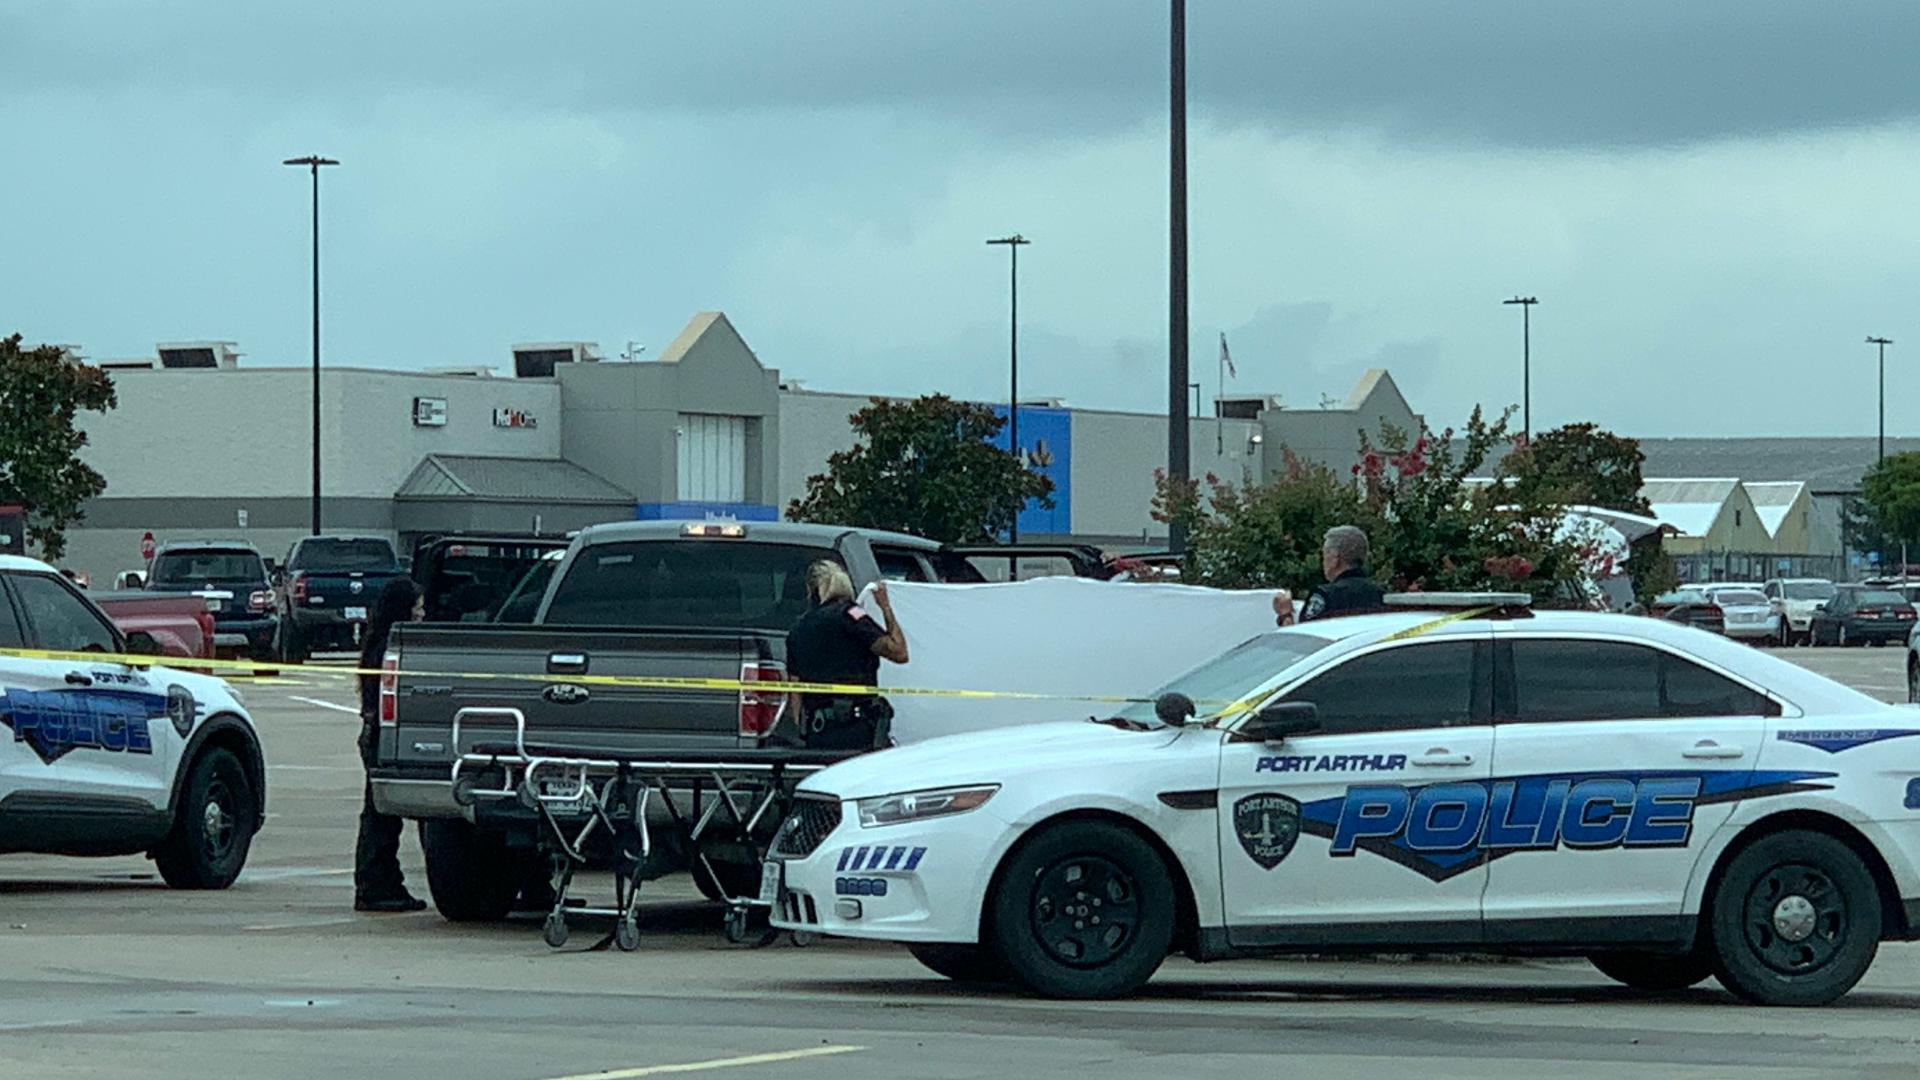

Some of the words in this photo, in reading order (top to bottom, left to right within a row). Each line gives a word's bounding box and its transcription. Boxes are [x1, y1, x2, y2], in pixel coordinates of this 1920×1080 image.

[5, 688, 152, 754] POLICE
[1256, 756, 1316, 772] PORT
[1314, 755, 1407, 772] ARTHUR
[1238, 799, 1262, 815] PORT
[1329, 777, 1701, 858] POLICE
[1254, 846, 1284, 857] POLICE
